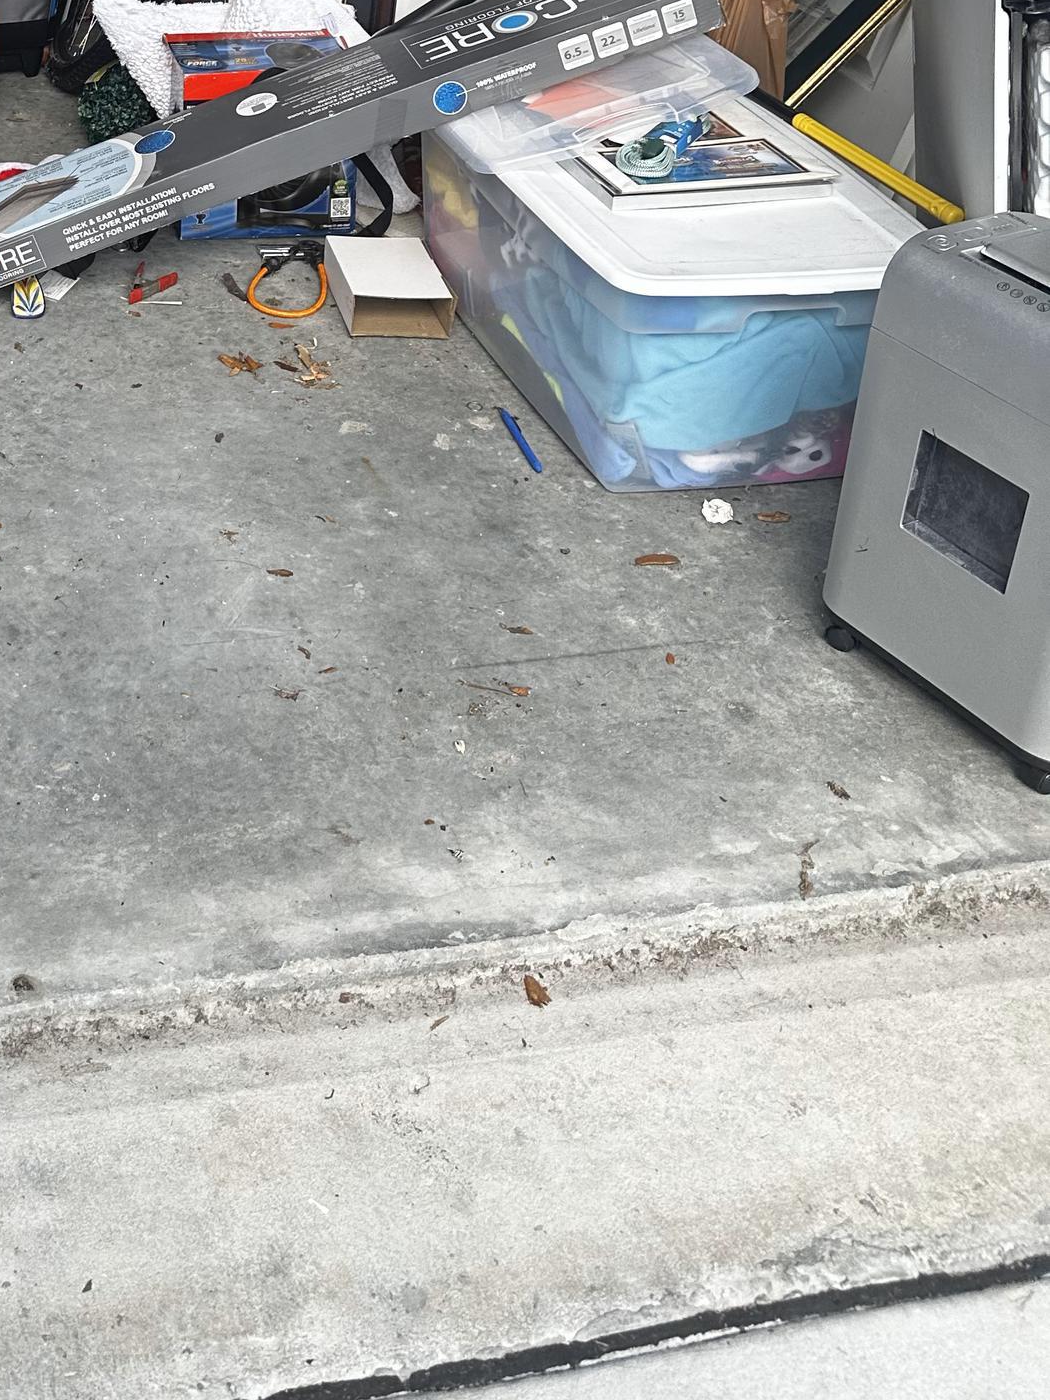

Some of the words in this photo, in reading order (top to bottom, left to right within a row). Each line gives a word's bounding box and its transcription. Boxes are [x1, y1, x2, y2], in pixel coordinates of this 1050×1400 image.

[673, 8, 685, 20] 15
[601, 34, 616, 47] 22
[564, 46, 582, 60] 6.5
[186, 59, 218, 68] FORCE
[62, 221, 88, 236] QUICK
[96, 210, 118, 223] EASY
[118, 187, 177, 214] INSTALLATION!
[65, 226, 98, 244] INSTALL
[98, 217, 122, 231] OVER
[121, 208, 145, 222] MOST
[145, 195, 182, 214] EXISTING
[182, 182, 215, 200] FLOORS
[69, 233, 106, 252] PERFECT
[105, 226, 123, 238] FOR
[123, 219, 141, 231] ANY
[141, 209, 169, 224] ROOM!
